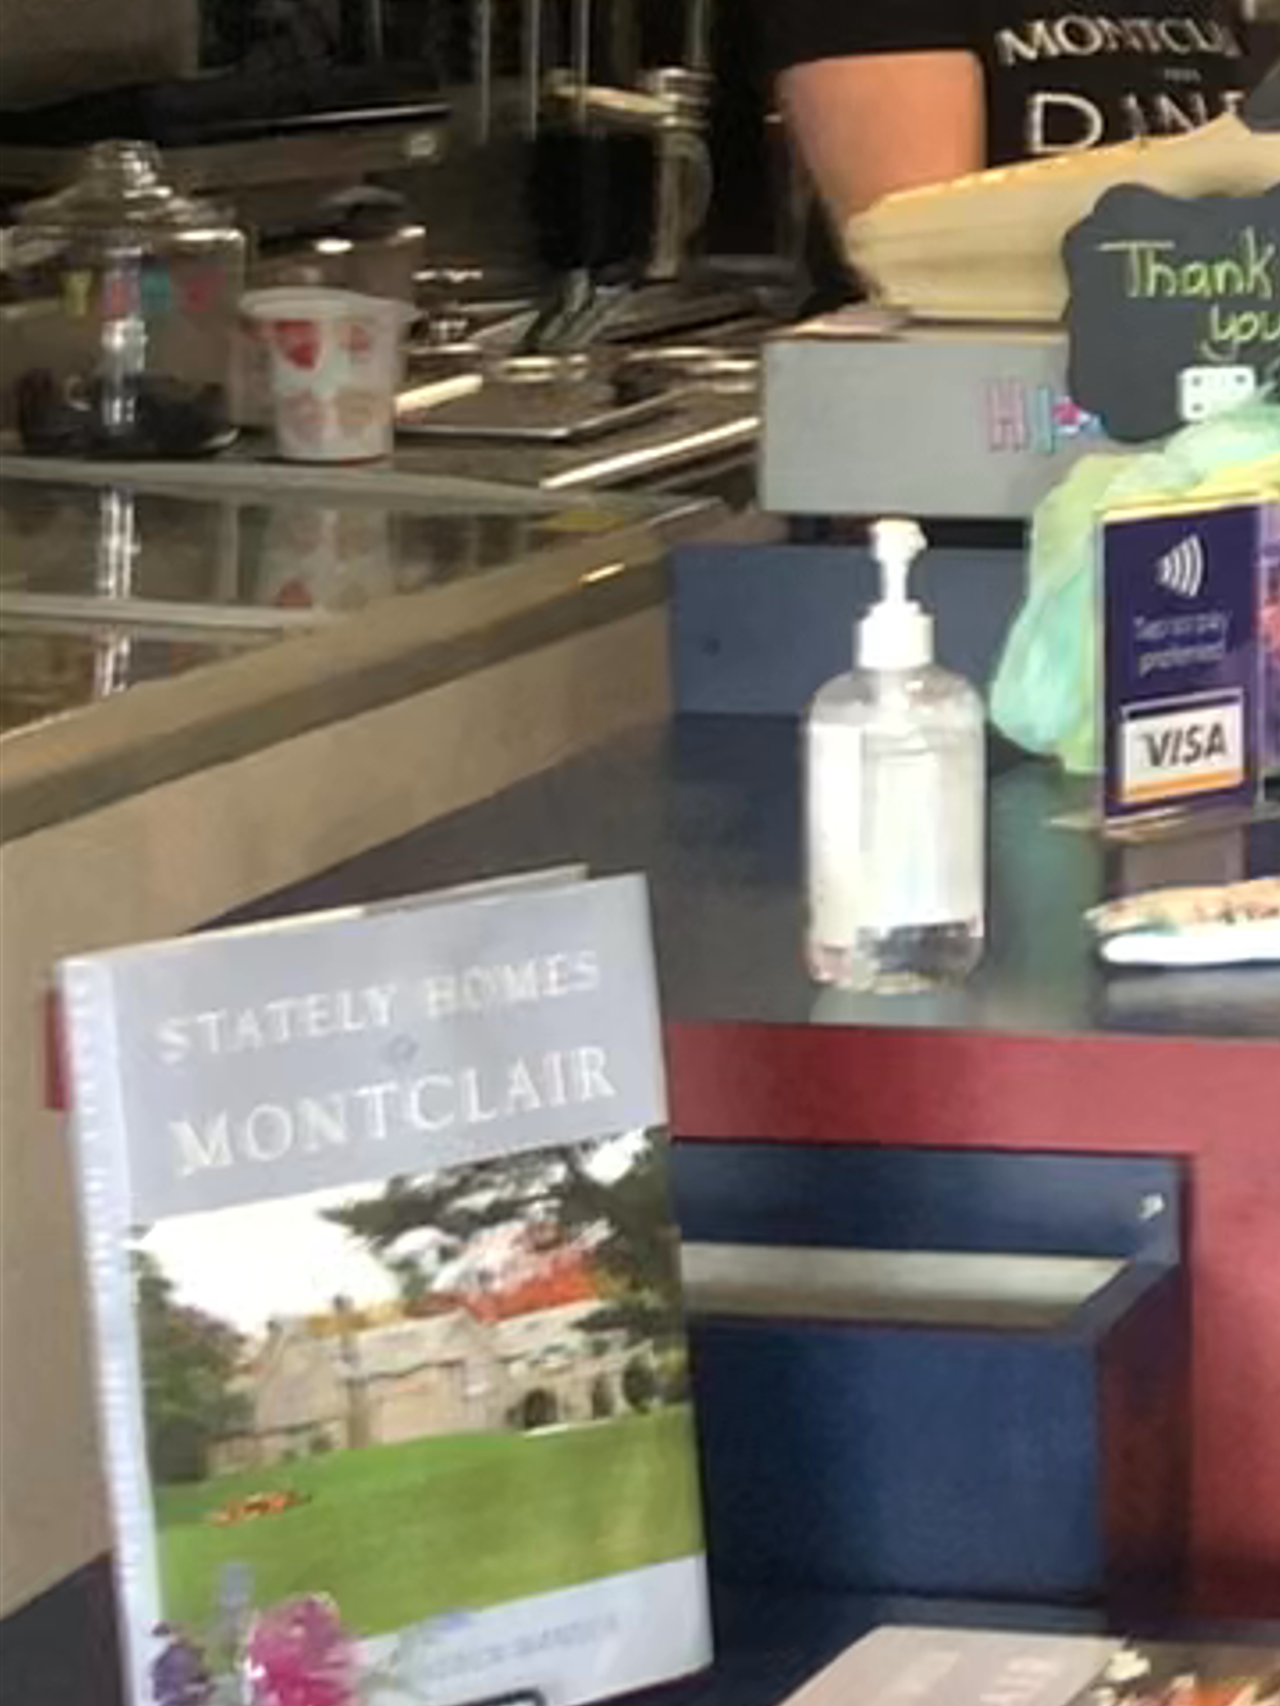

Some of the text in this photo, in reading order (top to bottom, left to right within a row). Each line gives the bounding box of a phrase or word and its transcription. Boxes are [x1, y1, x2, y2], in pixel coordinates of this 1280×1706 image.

[1096, 225, 1278, 300] Thank
[1143, 722, 1228, 768] VISA
[153, 982, 398, 1064] STATELY
[424, 949, 601, 1018] HOMES
[169, 1044, 617, 1177] MONTCLAIR
